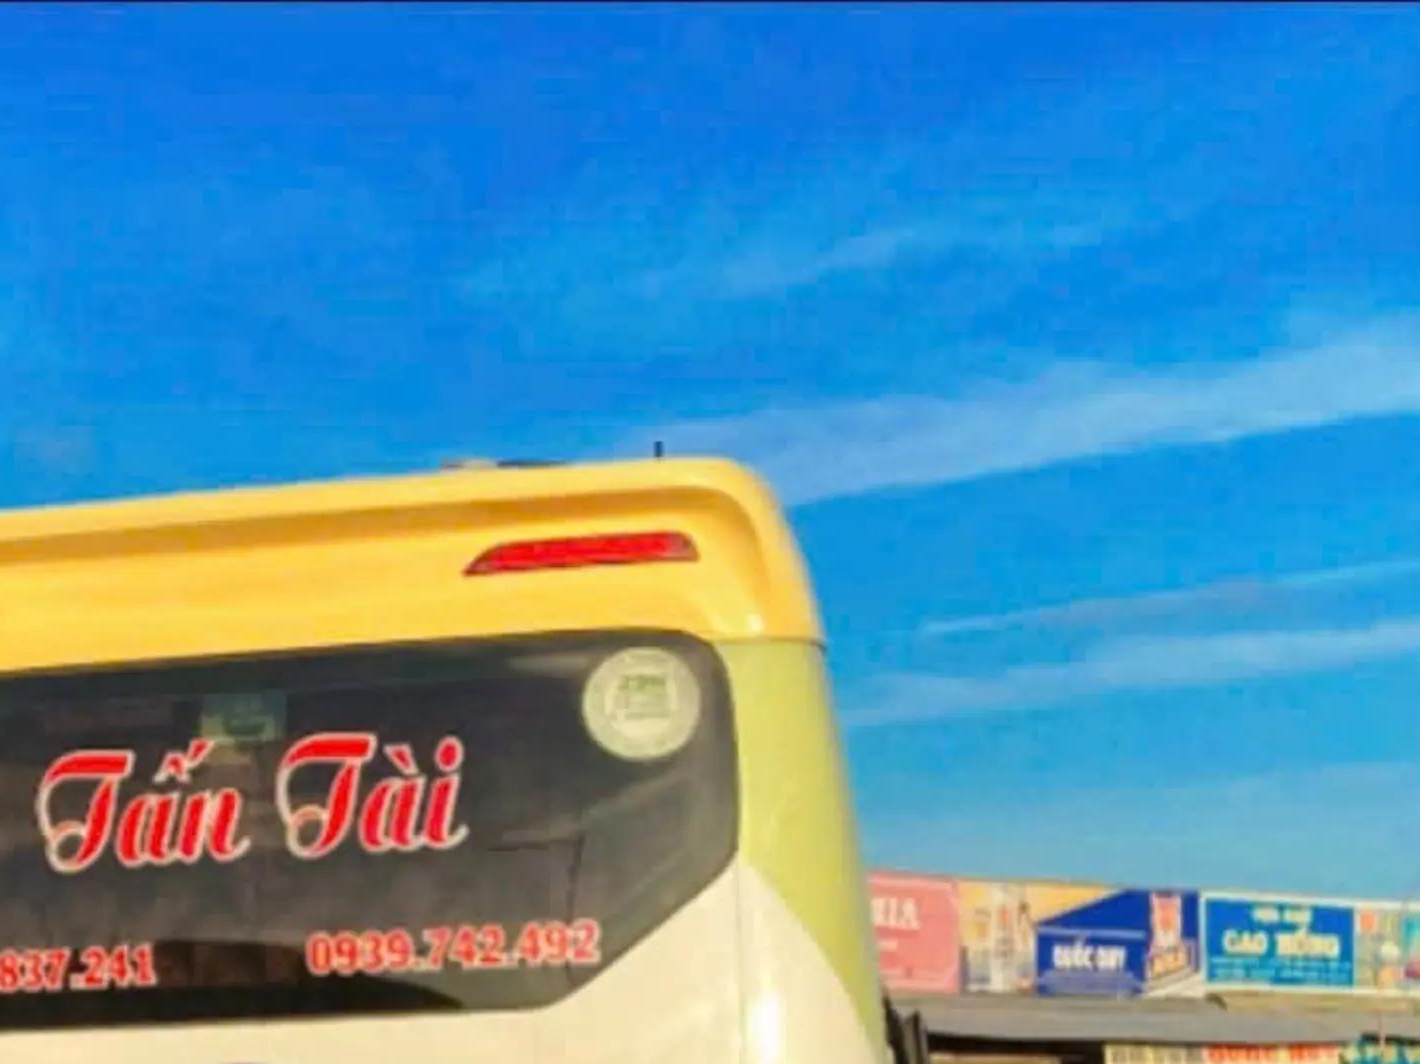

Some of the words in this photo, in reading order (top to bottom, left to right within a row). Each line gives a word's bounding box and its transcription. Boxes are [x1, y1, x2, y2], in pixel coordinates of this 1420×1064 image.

[36, 737, 251, 874] Tấn
[276, 732, 469, 860] Tài
[305, 917, 602, 977] 0939.742.492
